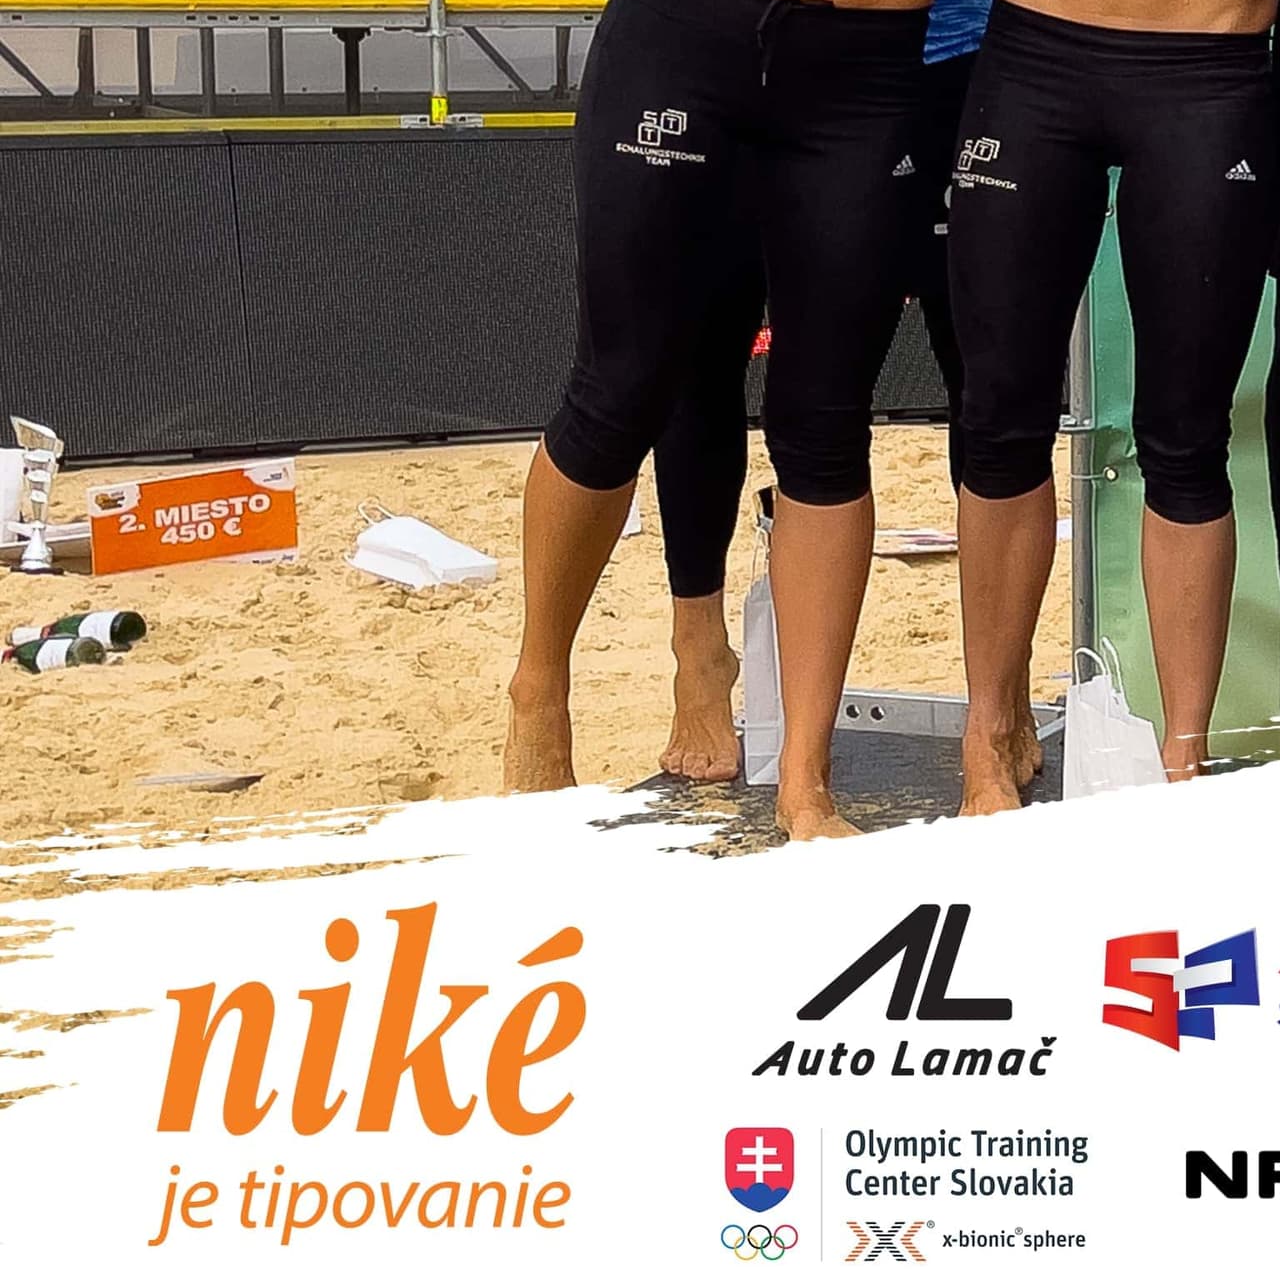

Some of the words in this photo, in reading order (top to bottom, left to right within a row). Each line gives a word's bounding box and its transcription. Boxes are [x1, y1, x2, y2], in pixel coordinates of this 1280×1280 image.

[119, 513, 147, 534] 2.
[153, 493, 272, 529] MIESTO
[160, 520, 216, 546] 450
[222, 516, 243, 537] €
